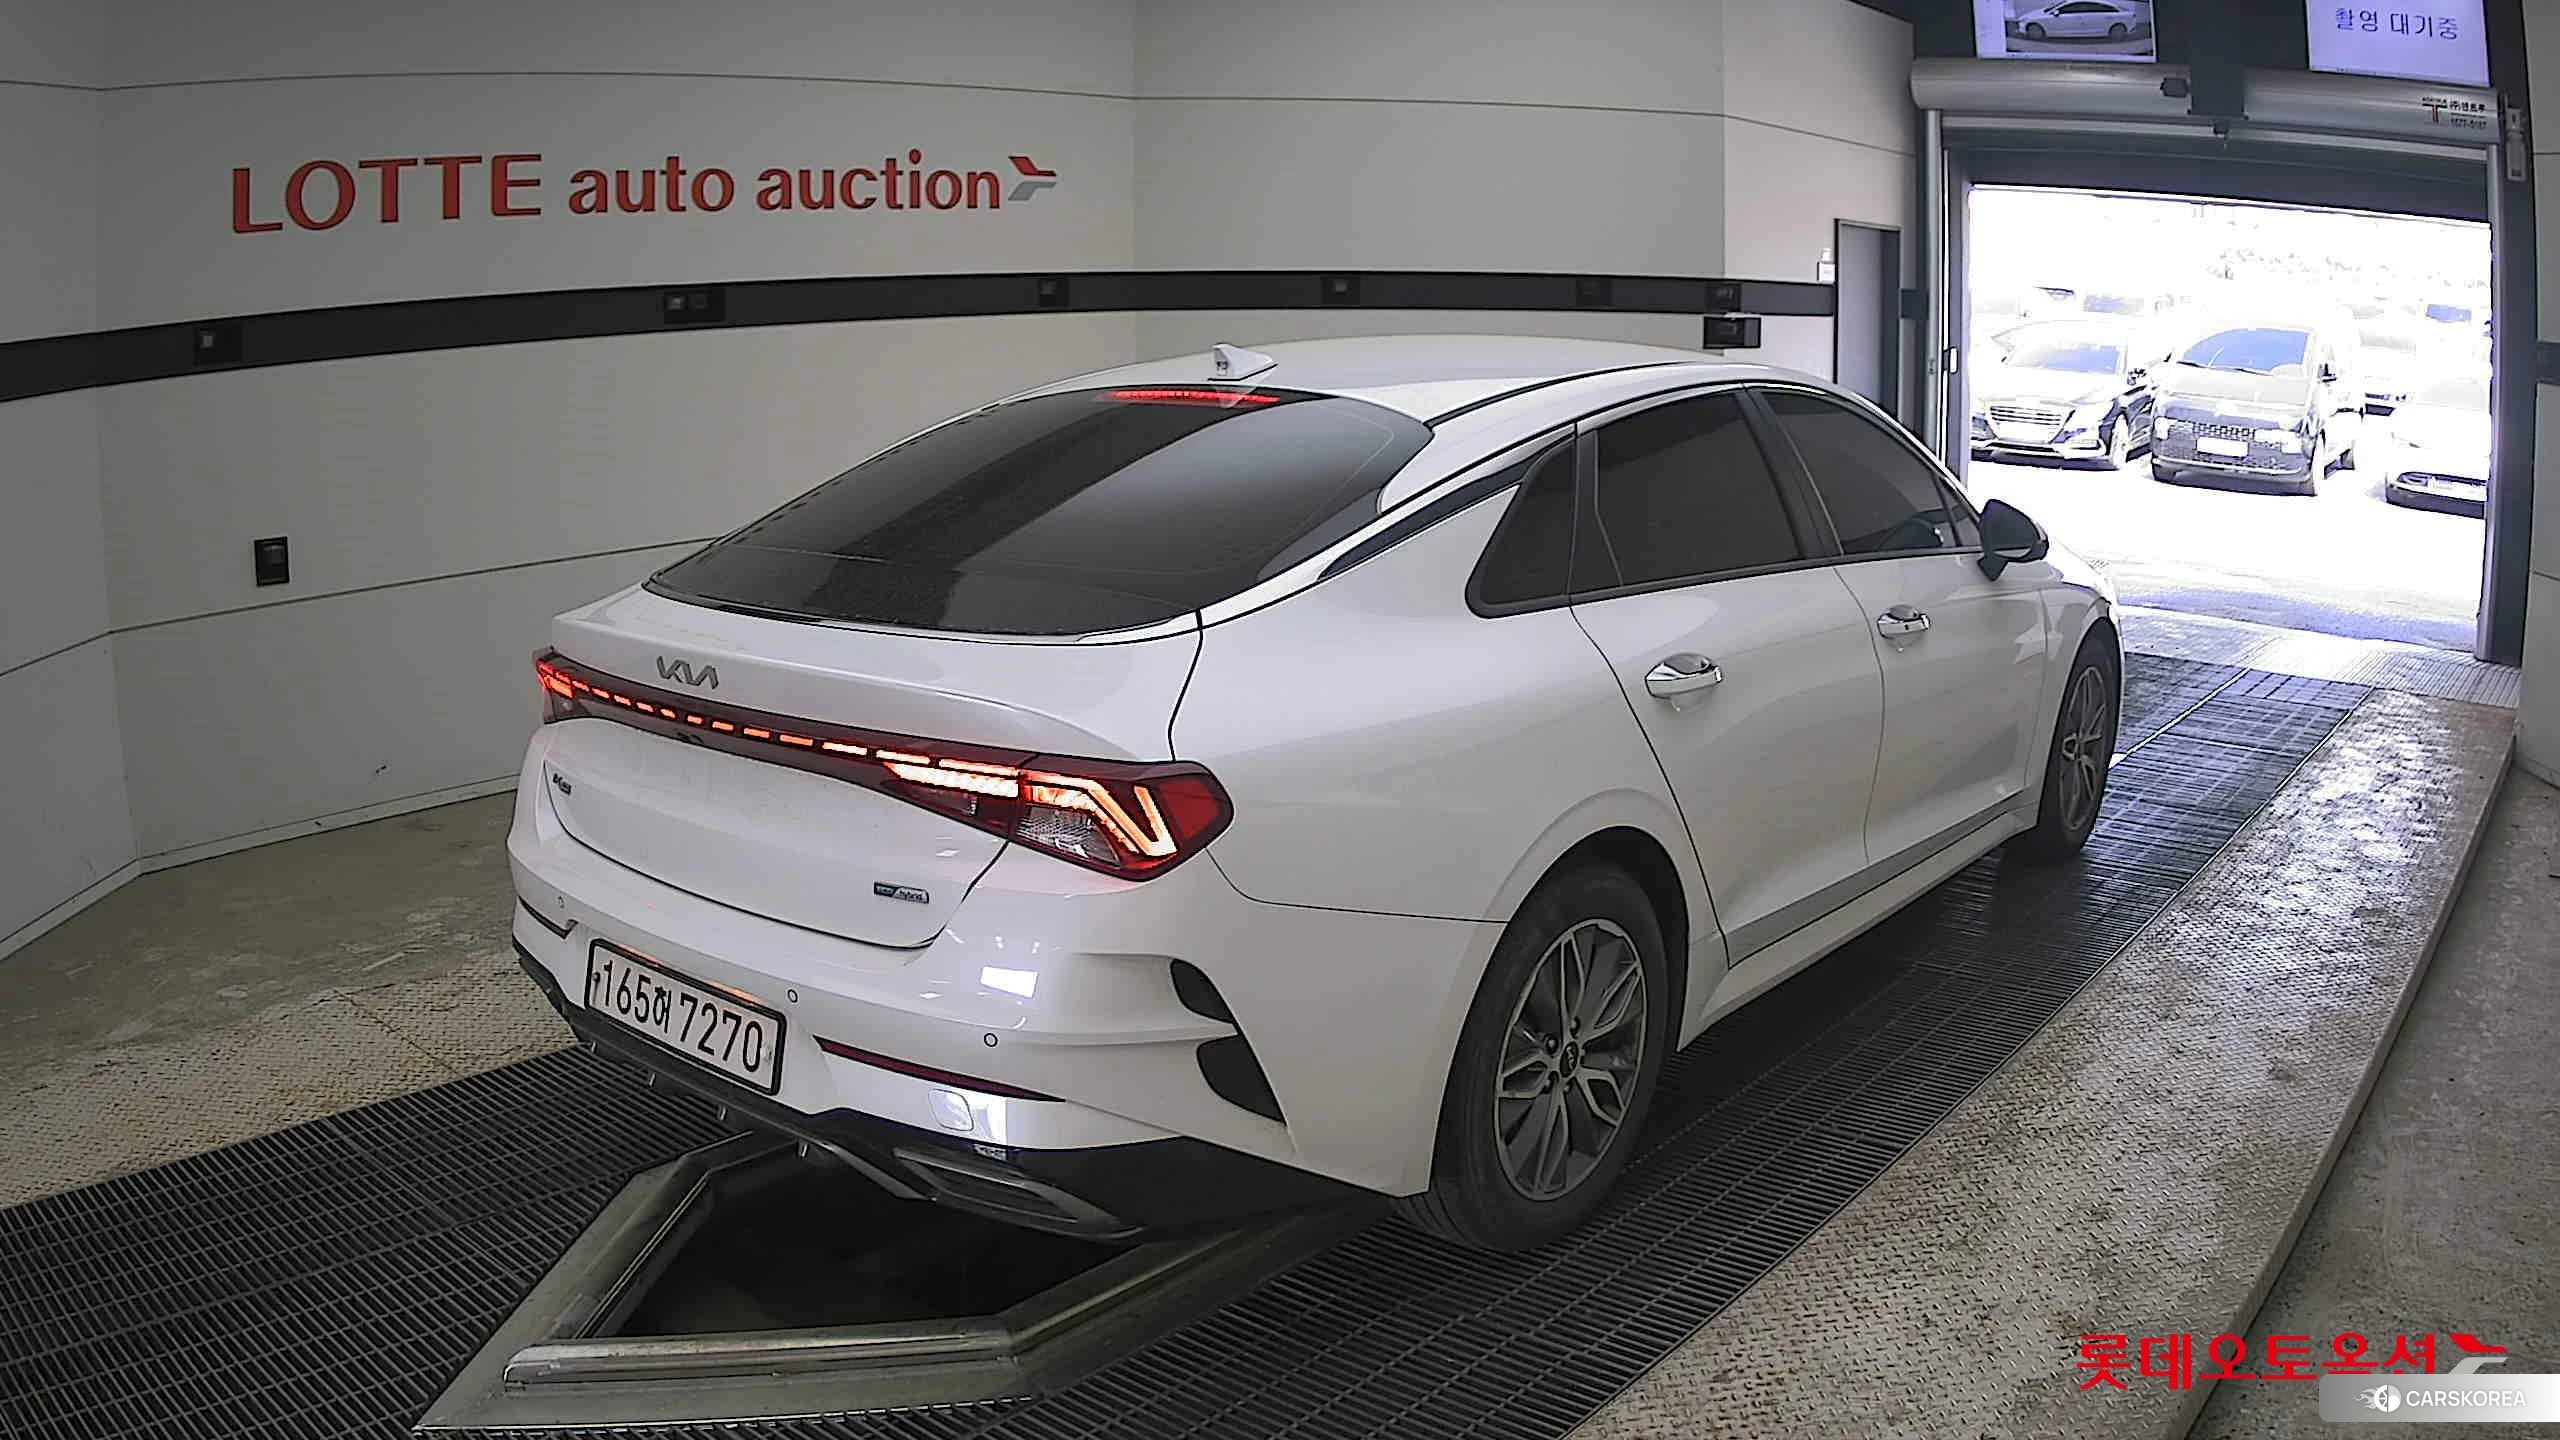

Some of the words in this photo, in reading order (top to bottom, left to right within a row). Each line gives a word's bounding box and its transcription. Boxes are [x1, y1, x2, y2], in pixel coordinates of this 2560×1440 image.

[2336, 8, 2378, 32] 촬영
[2390, 13, 2458, 40] 대기중
[232, 153, 542, 233] LOTTE
[568, 155, 734, 214] auto
[756, 149, 1001, 211] auction
[679, 992, 763, 1072] 7270
